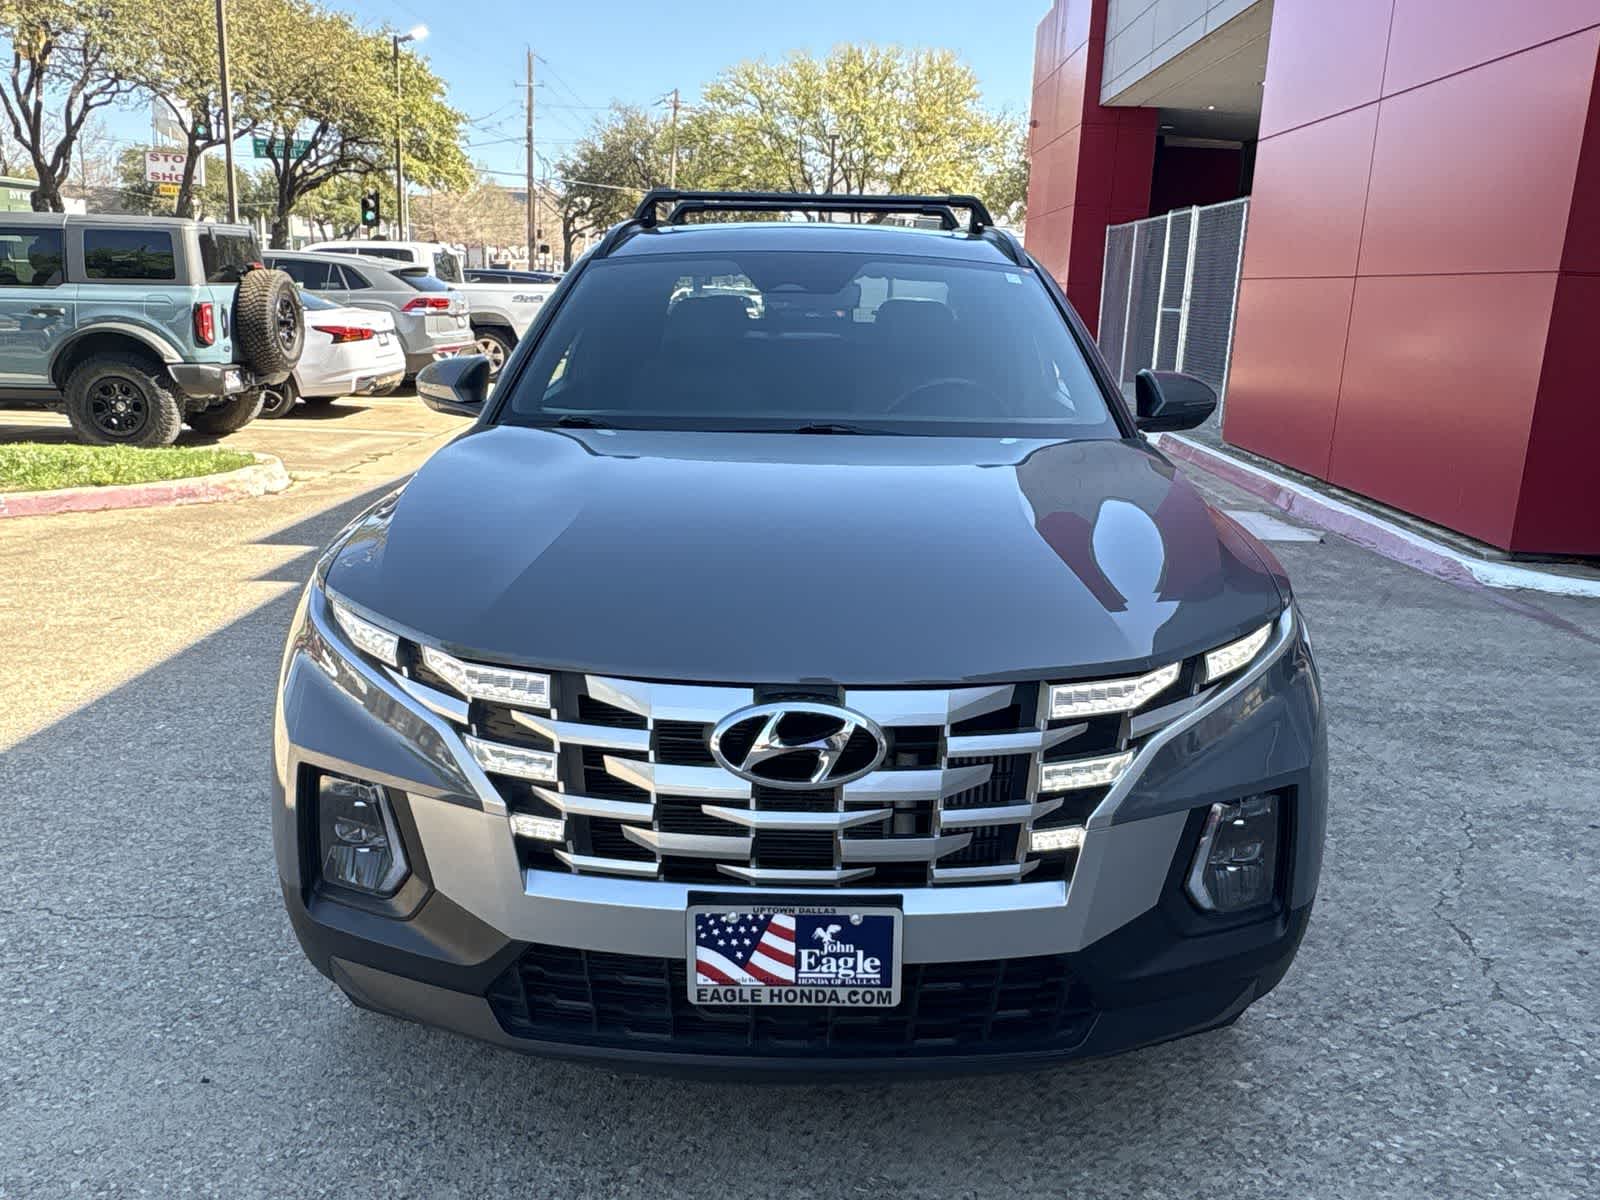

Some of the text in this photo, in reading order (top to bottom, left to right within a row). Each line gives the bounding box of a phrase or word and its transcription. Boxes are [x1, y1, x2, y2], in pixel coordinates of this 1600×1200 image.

[149, 153, 185, 163] STO
[150, 172, 197, 182] SHO
[821, 941, 855, 954] John
[798, 949, 881, 979] Eagle
[697, 989, 892, 1005] EAGLE HONDA.COM
